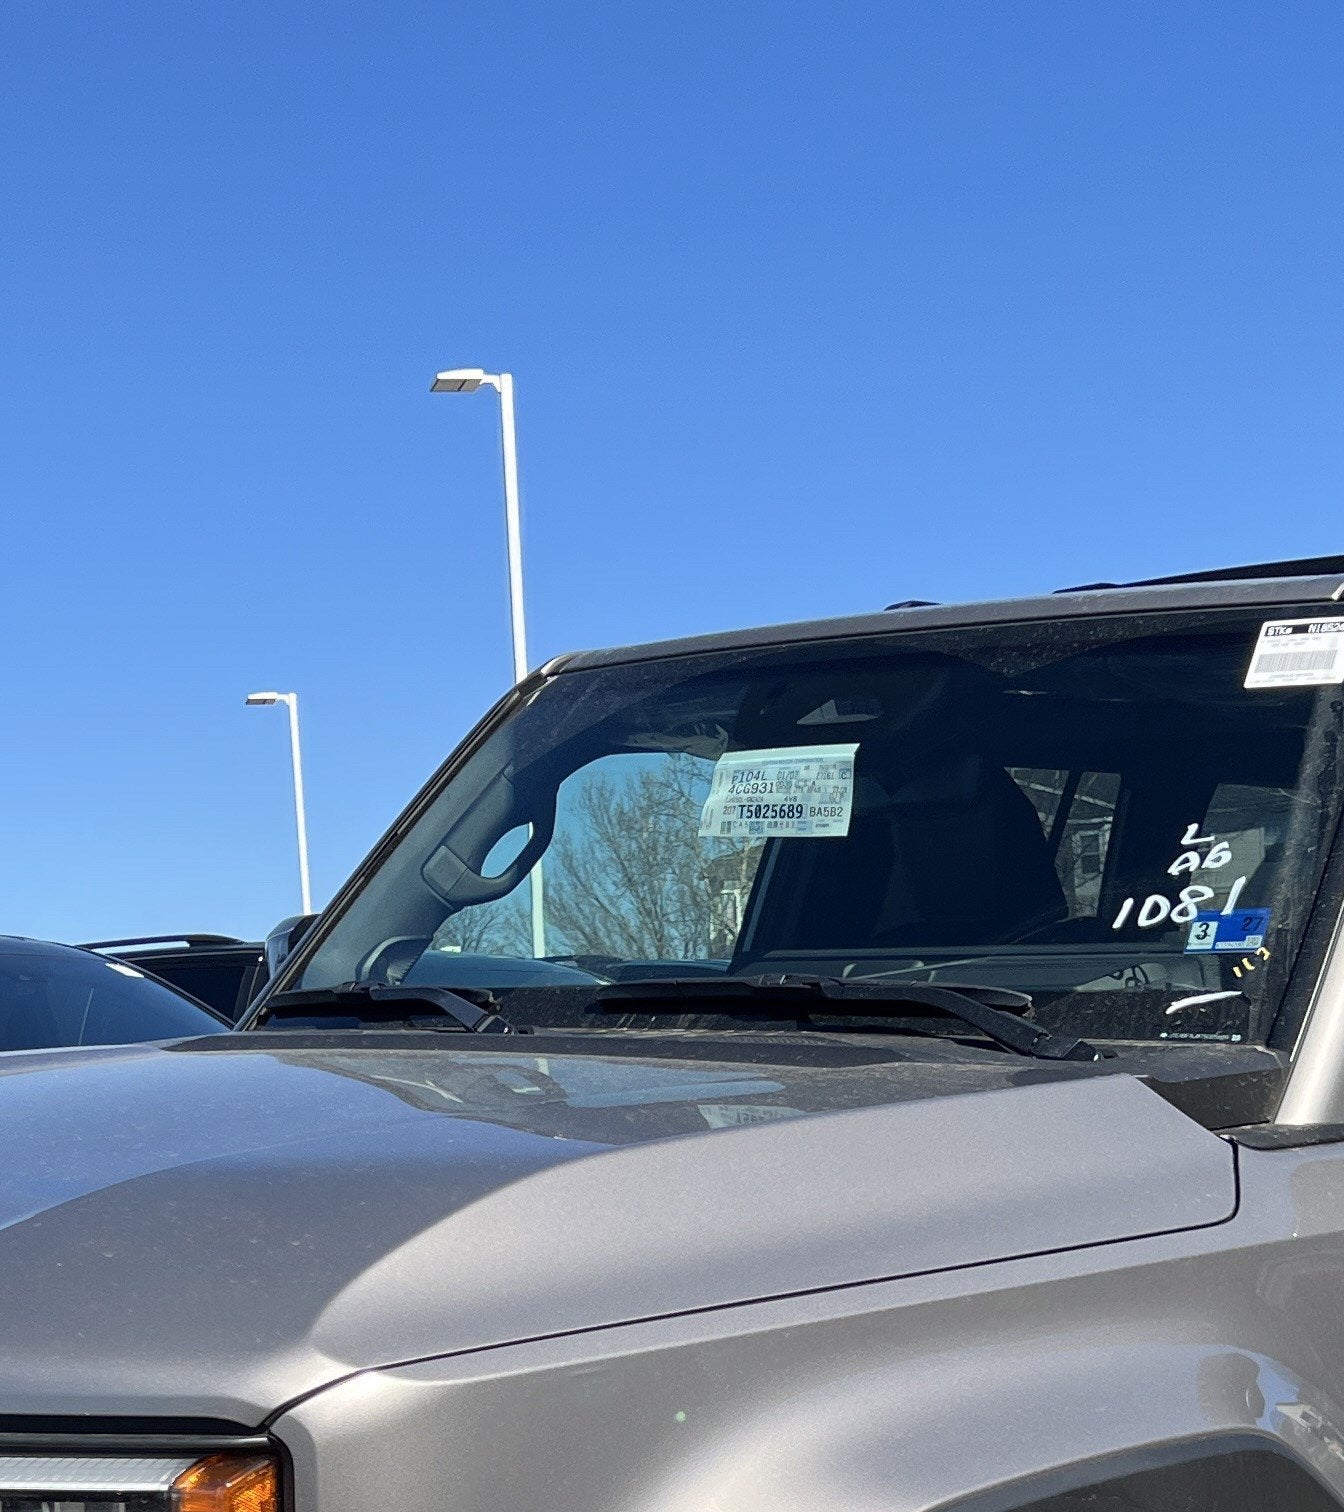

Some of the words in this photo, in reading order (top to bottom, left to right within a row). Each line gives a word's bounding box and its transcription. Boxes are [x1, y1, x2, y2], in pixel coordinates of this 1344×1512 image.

[739, 804, 804, 819] T5025689
[1112, 876, 1246, 929] 1081
[1196, 922, 1210, 940] 3
[1241, 916, 1264, 931] 27
